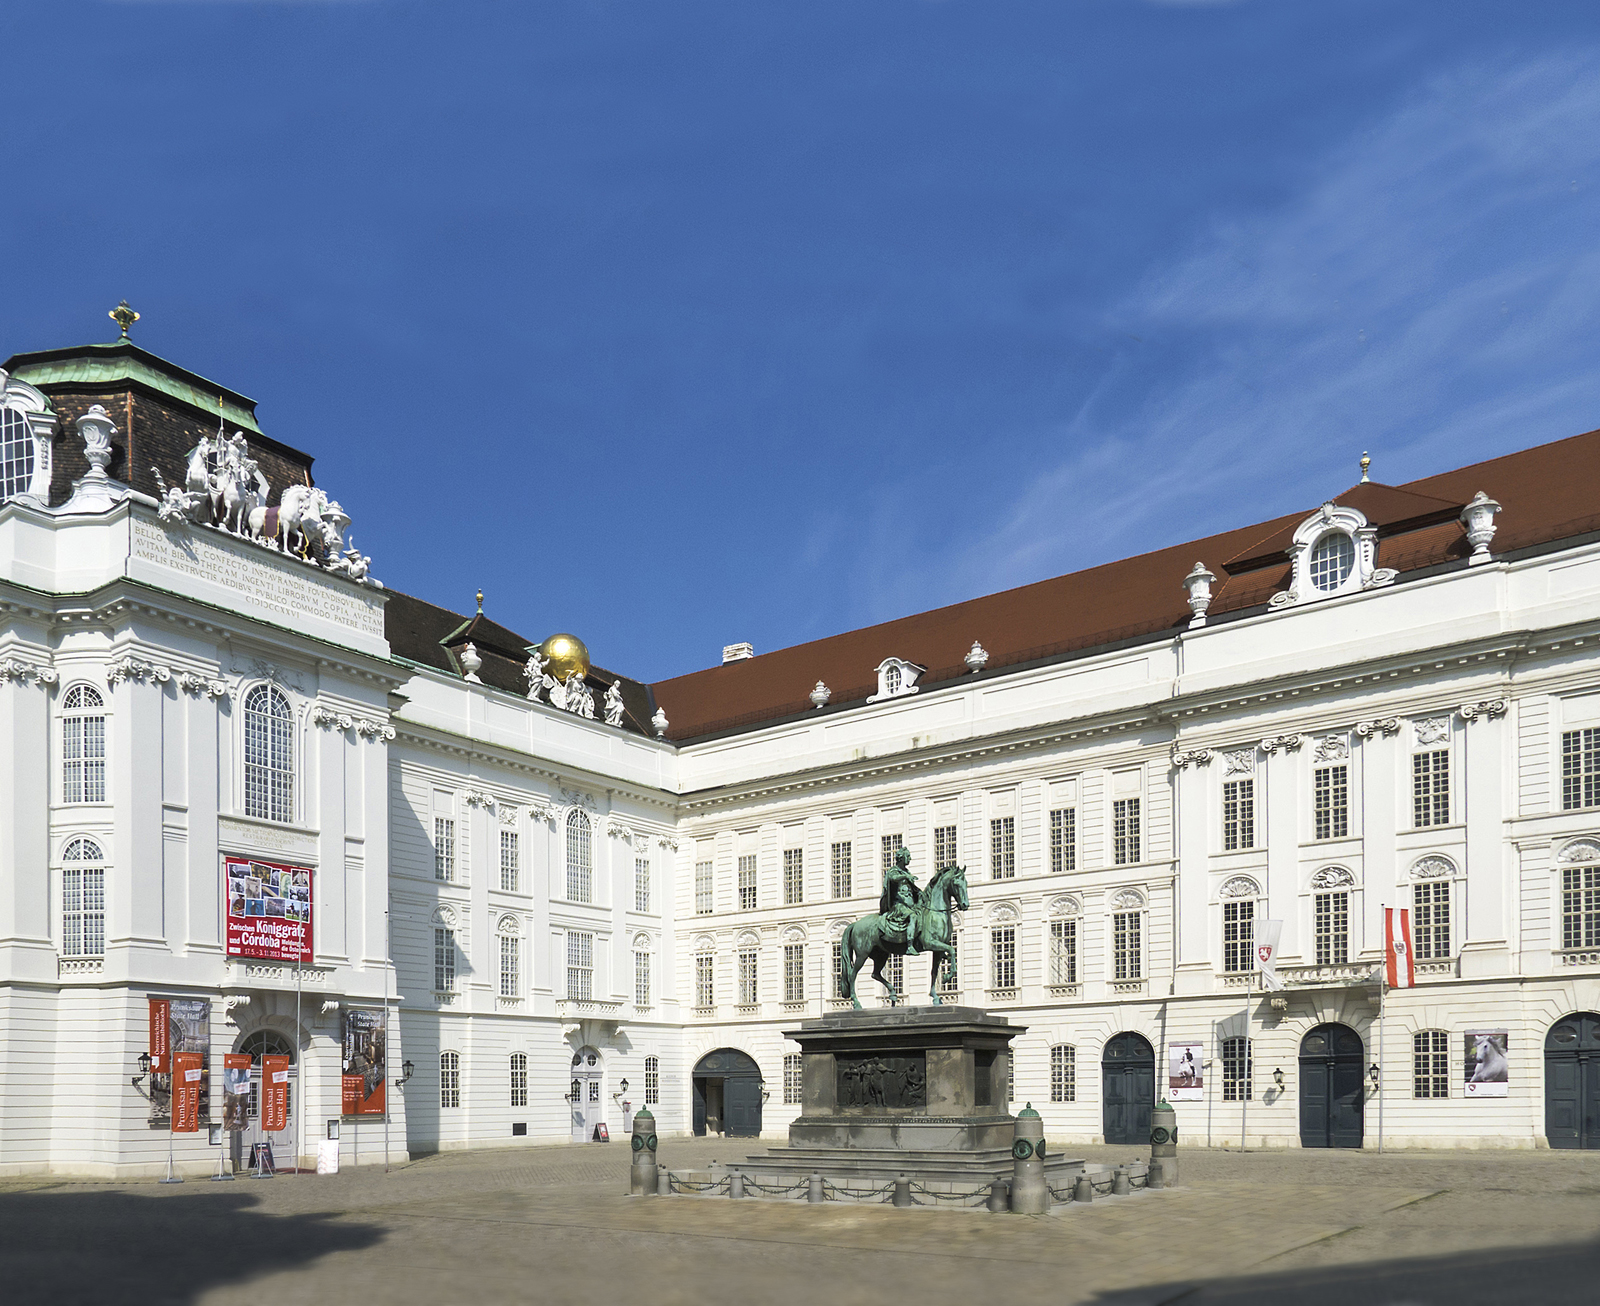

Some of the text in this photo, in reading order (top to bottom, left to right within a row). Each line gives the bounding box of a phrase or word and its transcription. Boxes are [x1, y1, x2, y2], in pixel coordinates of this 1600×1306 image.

[203, 550, 249, 572] CONFECTO
[135, 538, 168, 555] AVITAM
[242, 573, 274, 591] INGENTI
[278, 586, 319, 606] LIBRORVM
[323, 601, 349, 617] COPIA
[353, 612, 383, 628] AVCTAM
[135, 549, 168, 565] AMPLIS
[170, 560, 217, 581] EXSTRVCTIS
[220, 577, 252, 593] AEDIBVS
[255, 587, 288, 605] PVBLICO
[291, 601, 331, 619] COMMODO
[334, 614, 359, 629] PATERE
[228, 922, 255, 932] Zwischen
[241, 932, 280, 948] Córdoba
[189, 1087, 197, 1105] Hall
[276, 1088, 284, 1105] Hall
[178, 1087, 186, 1128] Prunksaal
[266, 1088, 274, 1126] Prunksaal
[276, 1106, 284, 1127] State
